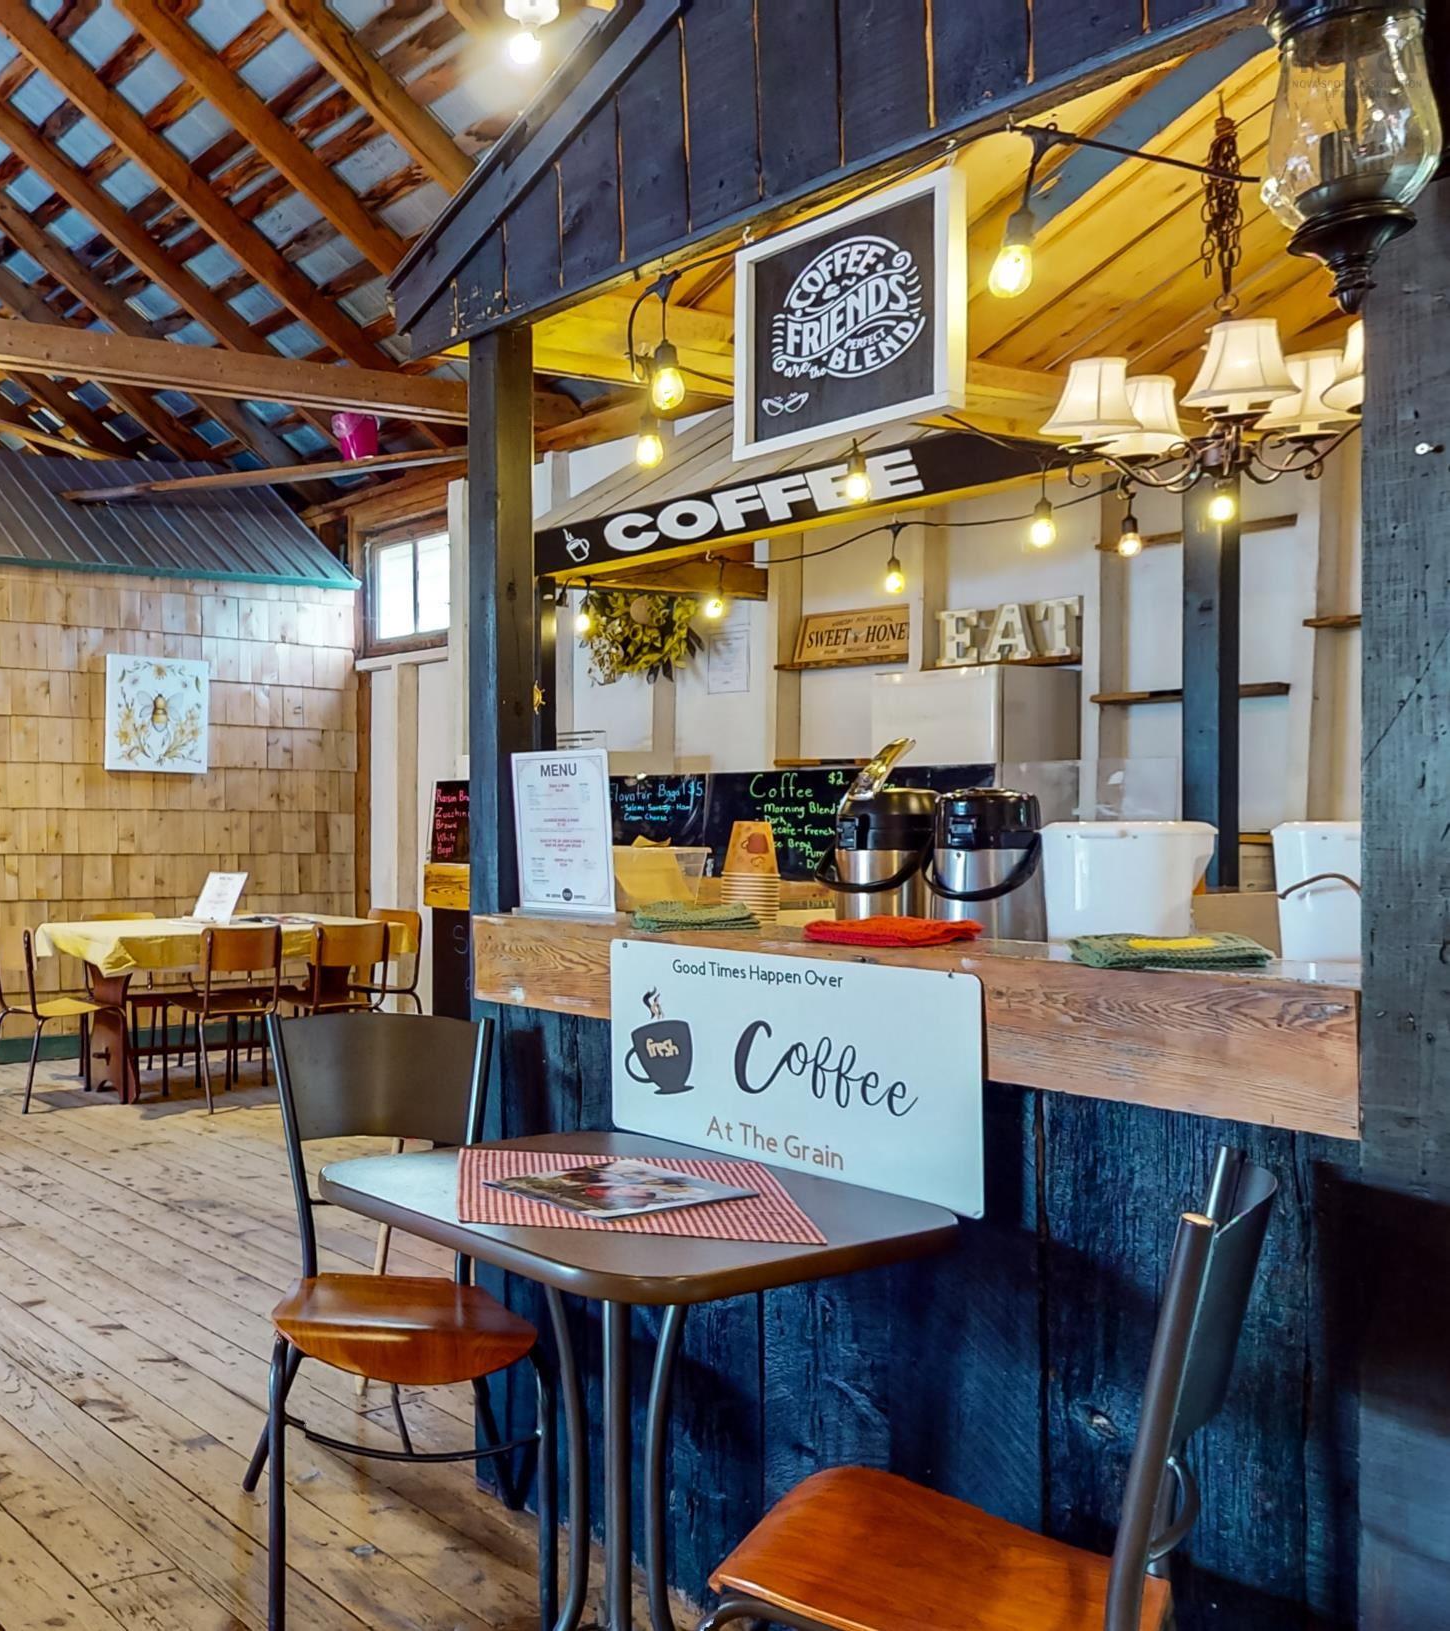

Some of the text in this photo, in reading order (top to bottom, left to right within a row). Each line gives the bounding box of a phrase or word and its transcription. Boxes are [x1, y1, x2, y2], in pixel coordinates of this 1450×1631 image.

[789, 243, 887, 310] COFFEE
[785, 274, 909, 357] FRIENDS
[783, 320, 916, 380] are the BLEND
[843, 326, 887, 350] PERFECT
[603, 448, 925, 553] COFFEE
[806, 621, 910, 649] SWEET HONE
[935, 595, 1082, 668] EAT
[540, 762, 577, 778] MENU
[750, 772, 814, 798] Coffee
[763, 802, 836, 818] Morning Blend
[772, 824, 796, 836] ecafe
[804, 825, 836, 836] French
[672, 959, 844, 989] Good Times Happen Over
[645, 1019, 919, 1117] fresh Coffee
[706, 1115, 845, 1171] At The Grain
